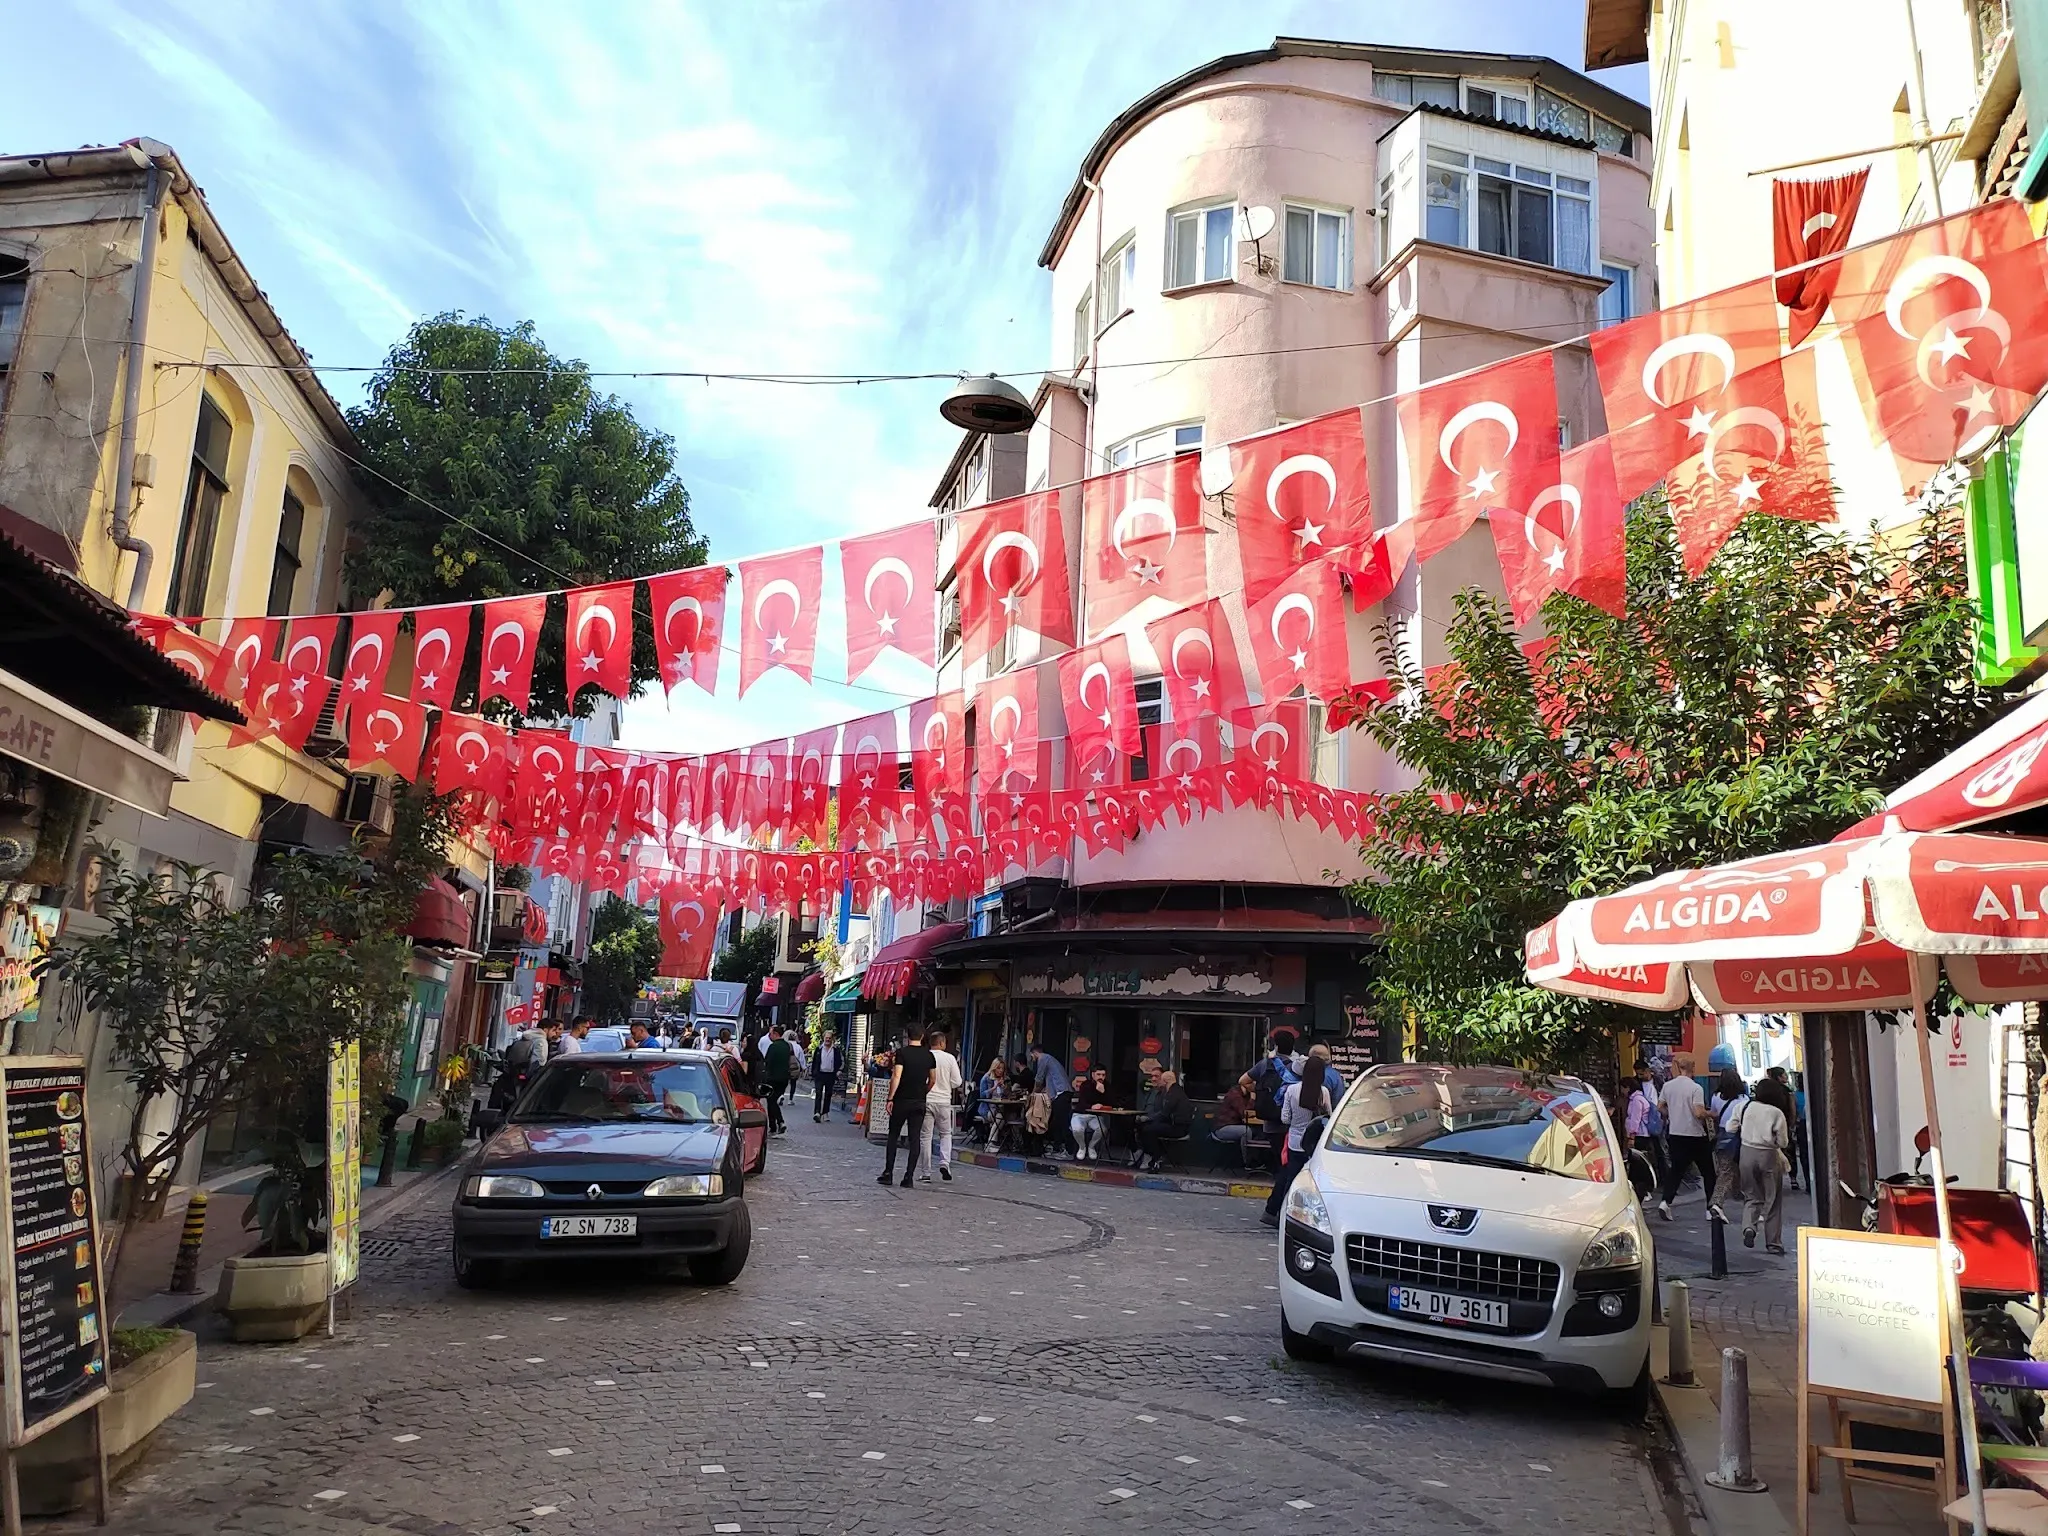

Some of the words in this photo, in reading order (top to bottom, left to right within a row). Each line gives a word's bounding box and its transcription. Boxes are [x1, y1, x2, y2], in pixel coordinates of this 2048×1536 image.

[553, 1219, 570, 1235] 42
[579, 1219, 596, 1234] SN
[604, 1218, 630, 1234] 738
[1400, 1289, 1420, 1311] 34
[1430, 1294, 1451, 1315] DV
[1460, 1299, 1503, 1324] 3611
[1814, 1304, 1844, 1320] TEA
[1858, 1312, 1912, 1331] COFFEE
